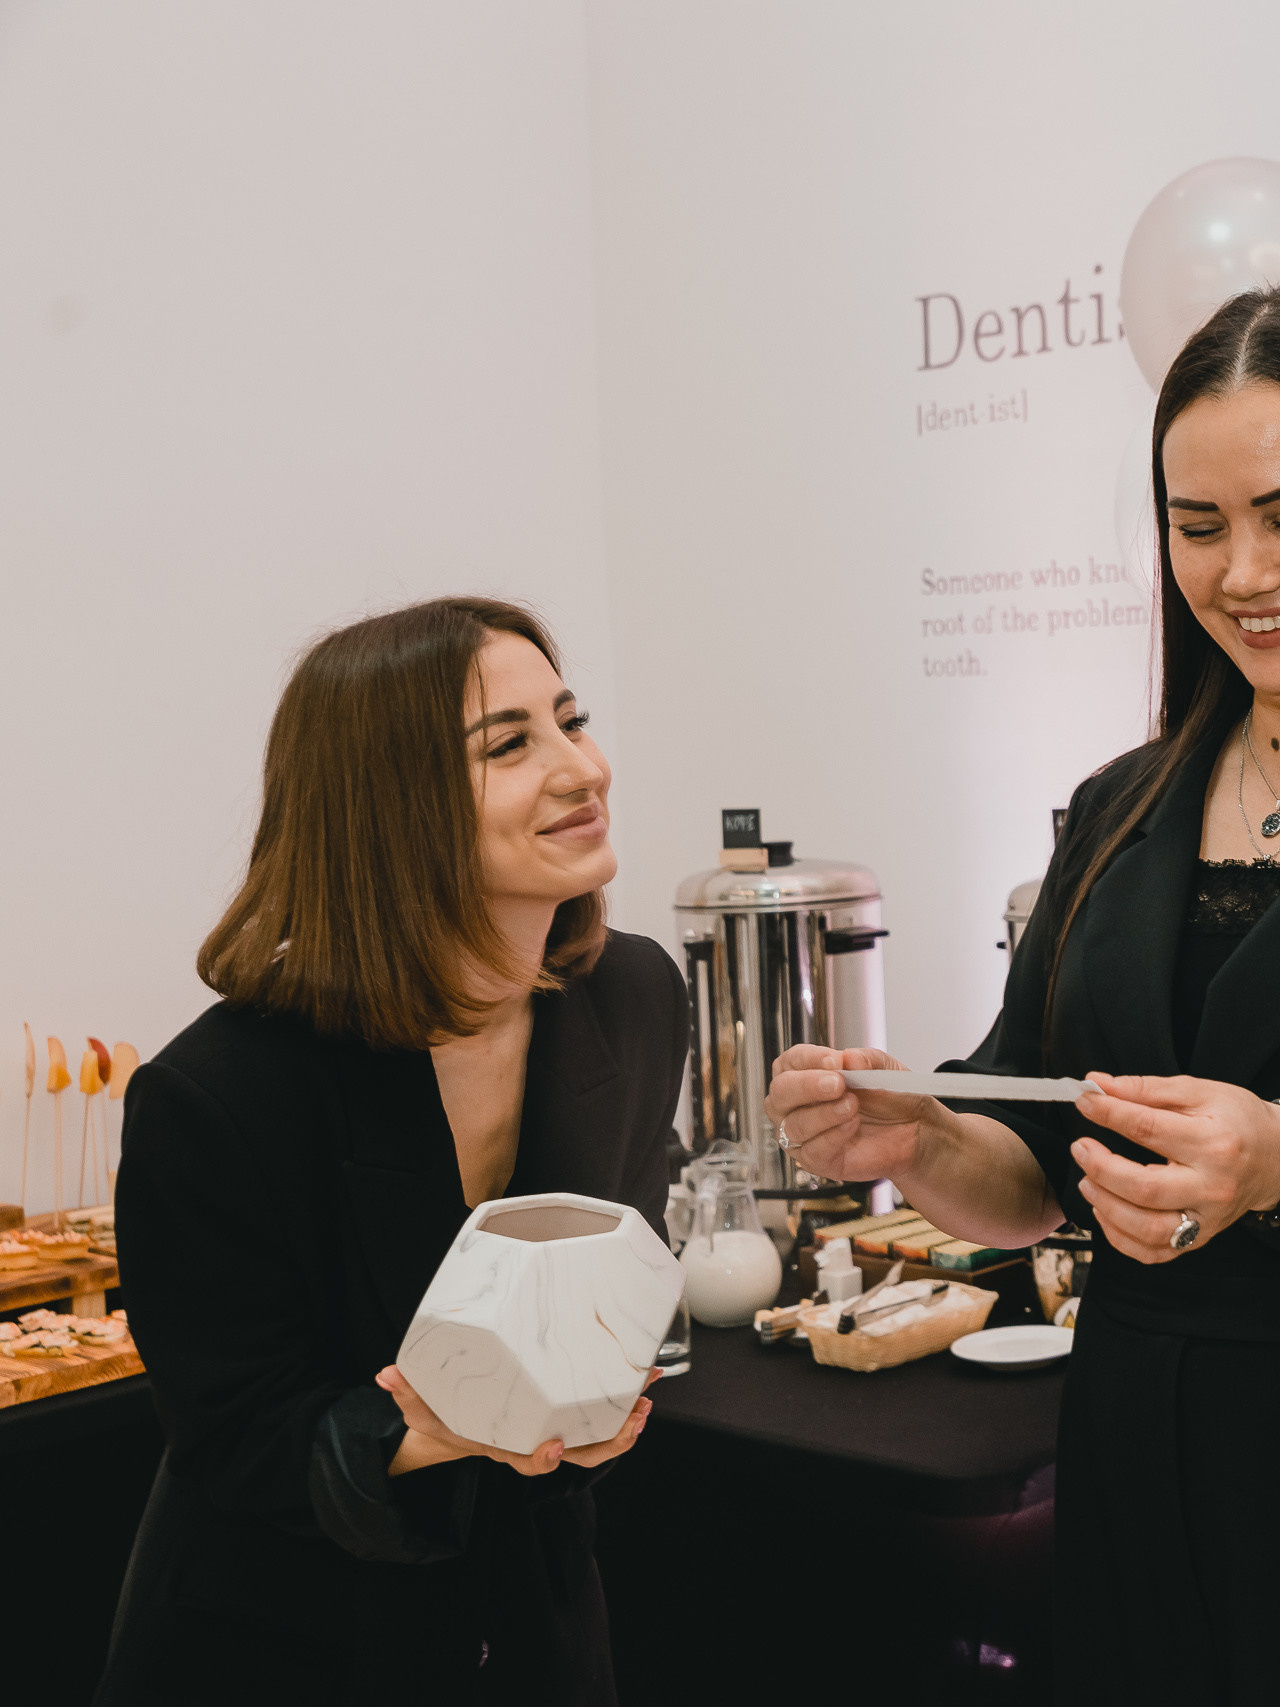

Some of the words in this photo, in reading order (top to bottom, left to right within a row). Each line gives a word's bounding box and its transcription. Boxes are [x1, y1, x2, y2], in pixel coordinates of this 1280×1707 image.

[914, 264, 1125, 371] Denti
[919, 566, 1024, 596] Someone
[1030, 559, 1081, 588] who
[921, 610, 967, 637] root
[972, 604, 996, 634] of
[1001, 604, 1039, 632] the
[1046, 598, 1149, 636] problem
[922, 649, 989, 678] tooth.
